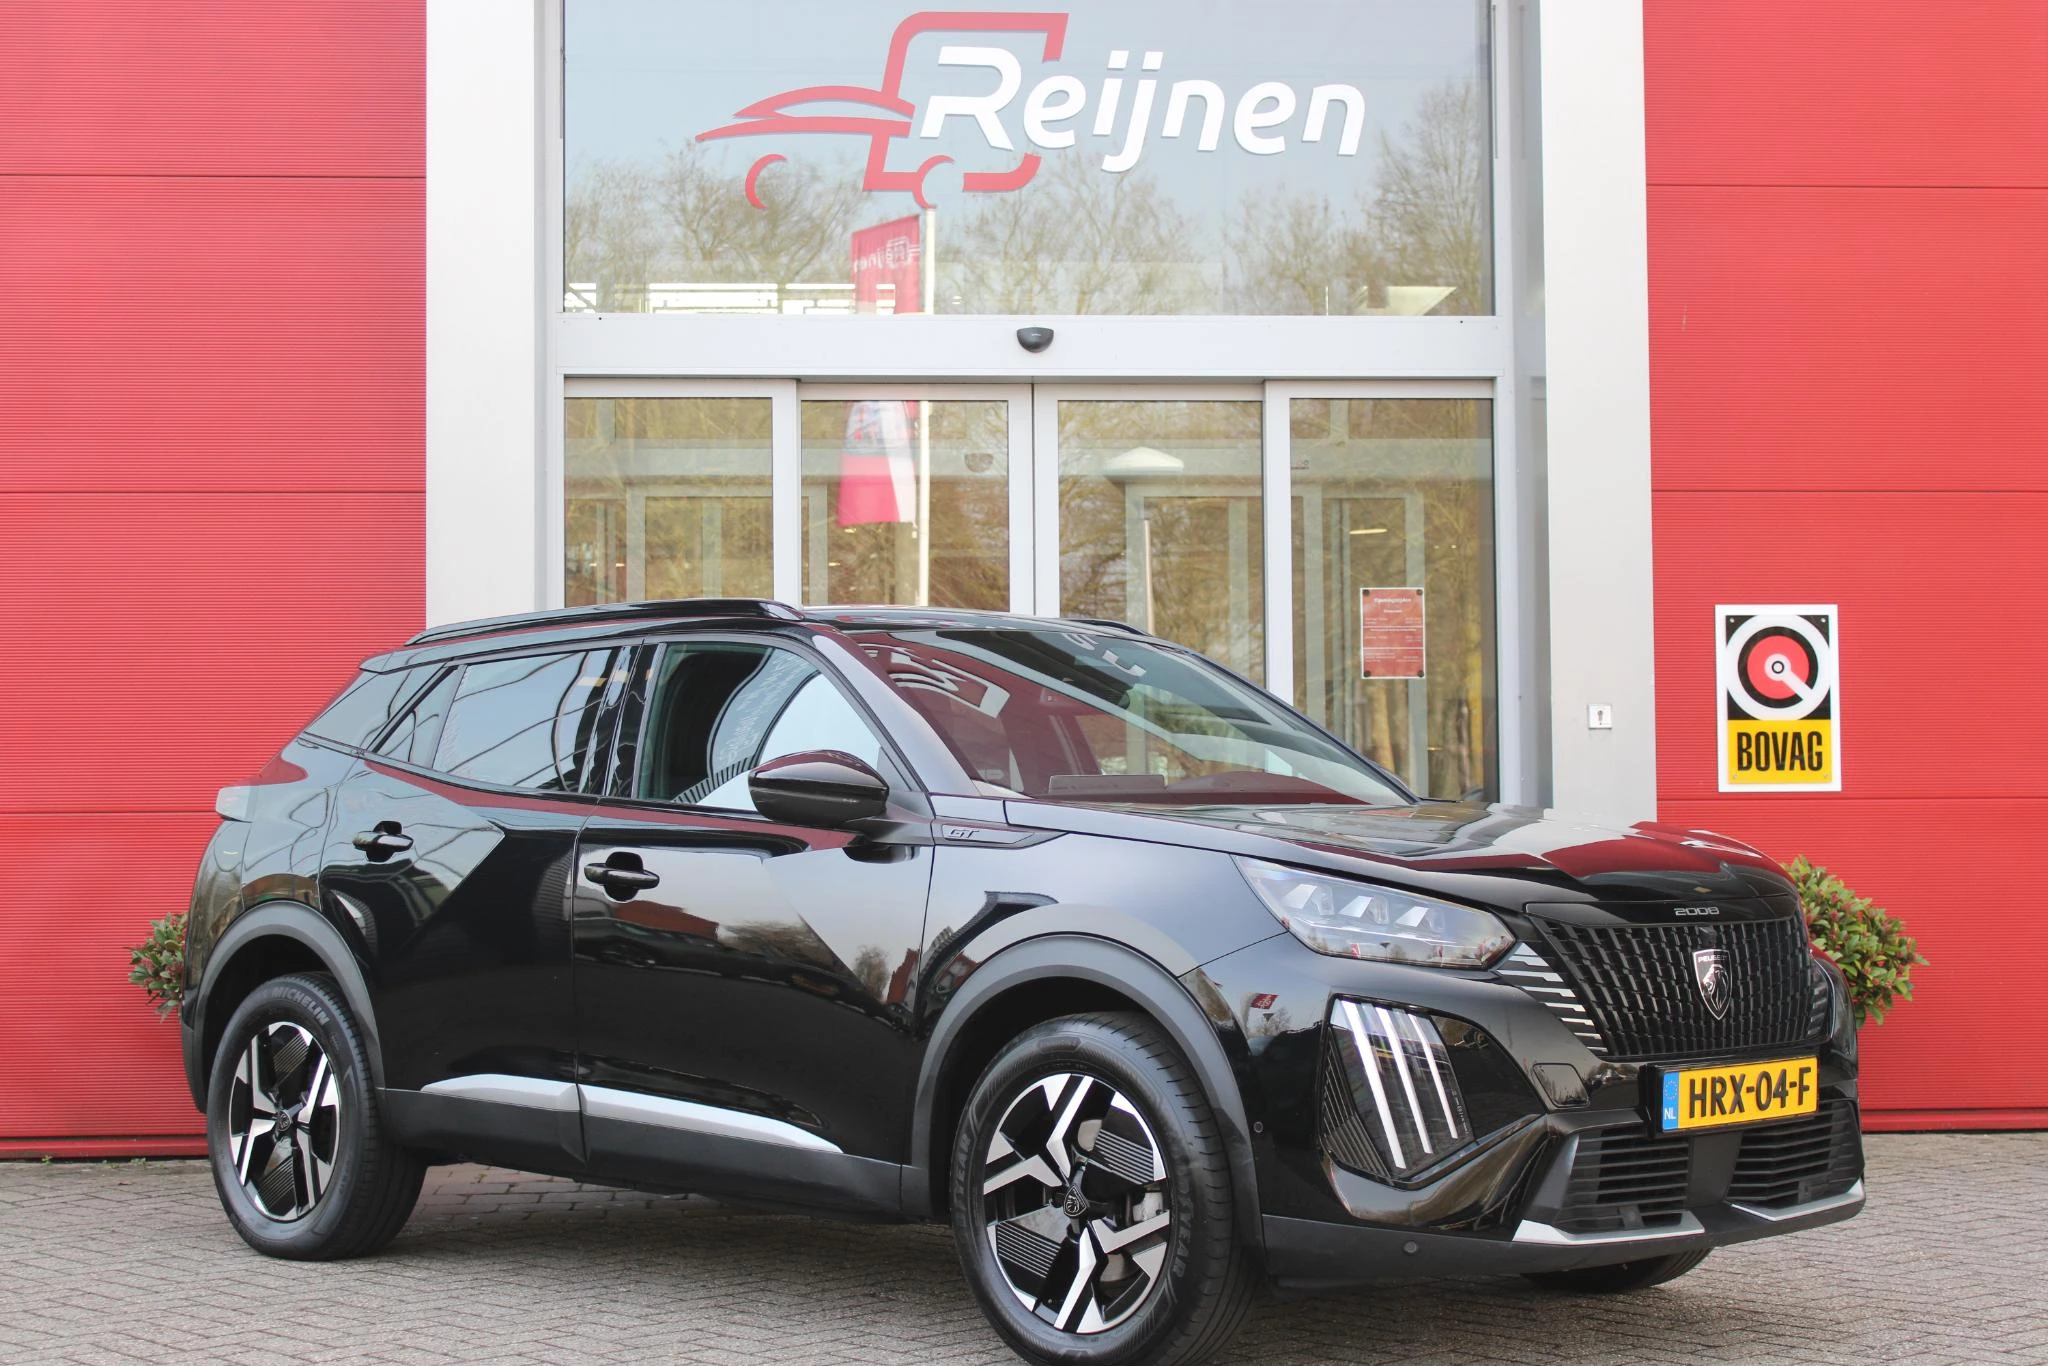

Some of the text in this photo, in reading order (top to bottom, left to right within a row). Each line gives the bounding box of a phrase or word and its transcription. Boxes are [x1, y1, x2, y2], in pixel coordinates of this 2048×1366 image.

[920, 46, 1366, 173] Reijnen
[1736, 731, 1823, 772] BOVAG
[948, 829, 980, 839] GT
[1673, 906, 1720, 916] 2008
[272, 987, 330, 1025] MICHELIN
[1688, 1065, 1812, 1119] HRX-04-F
[1664, 1107, 1676, 1120] NL
